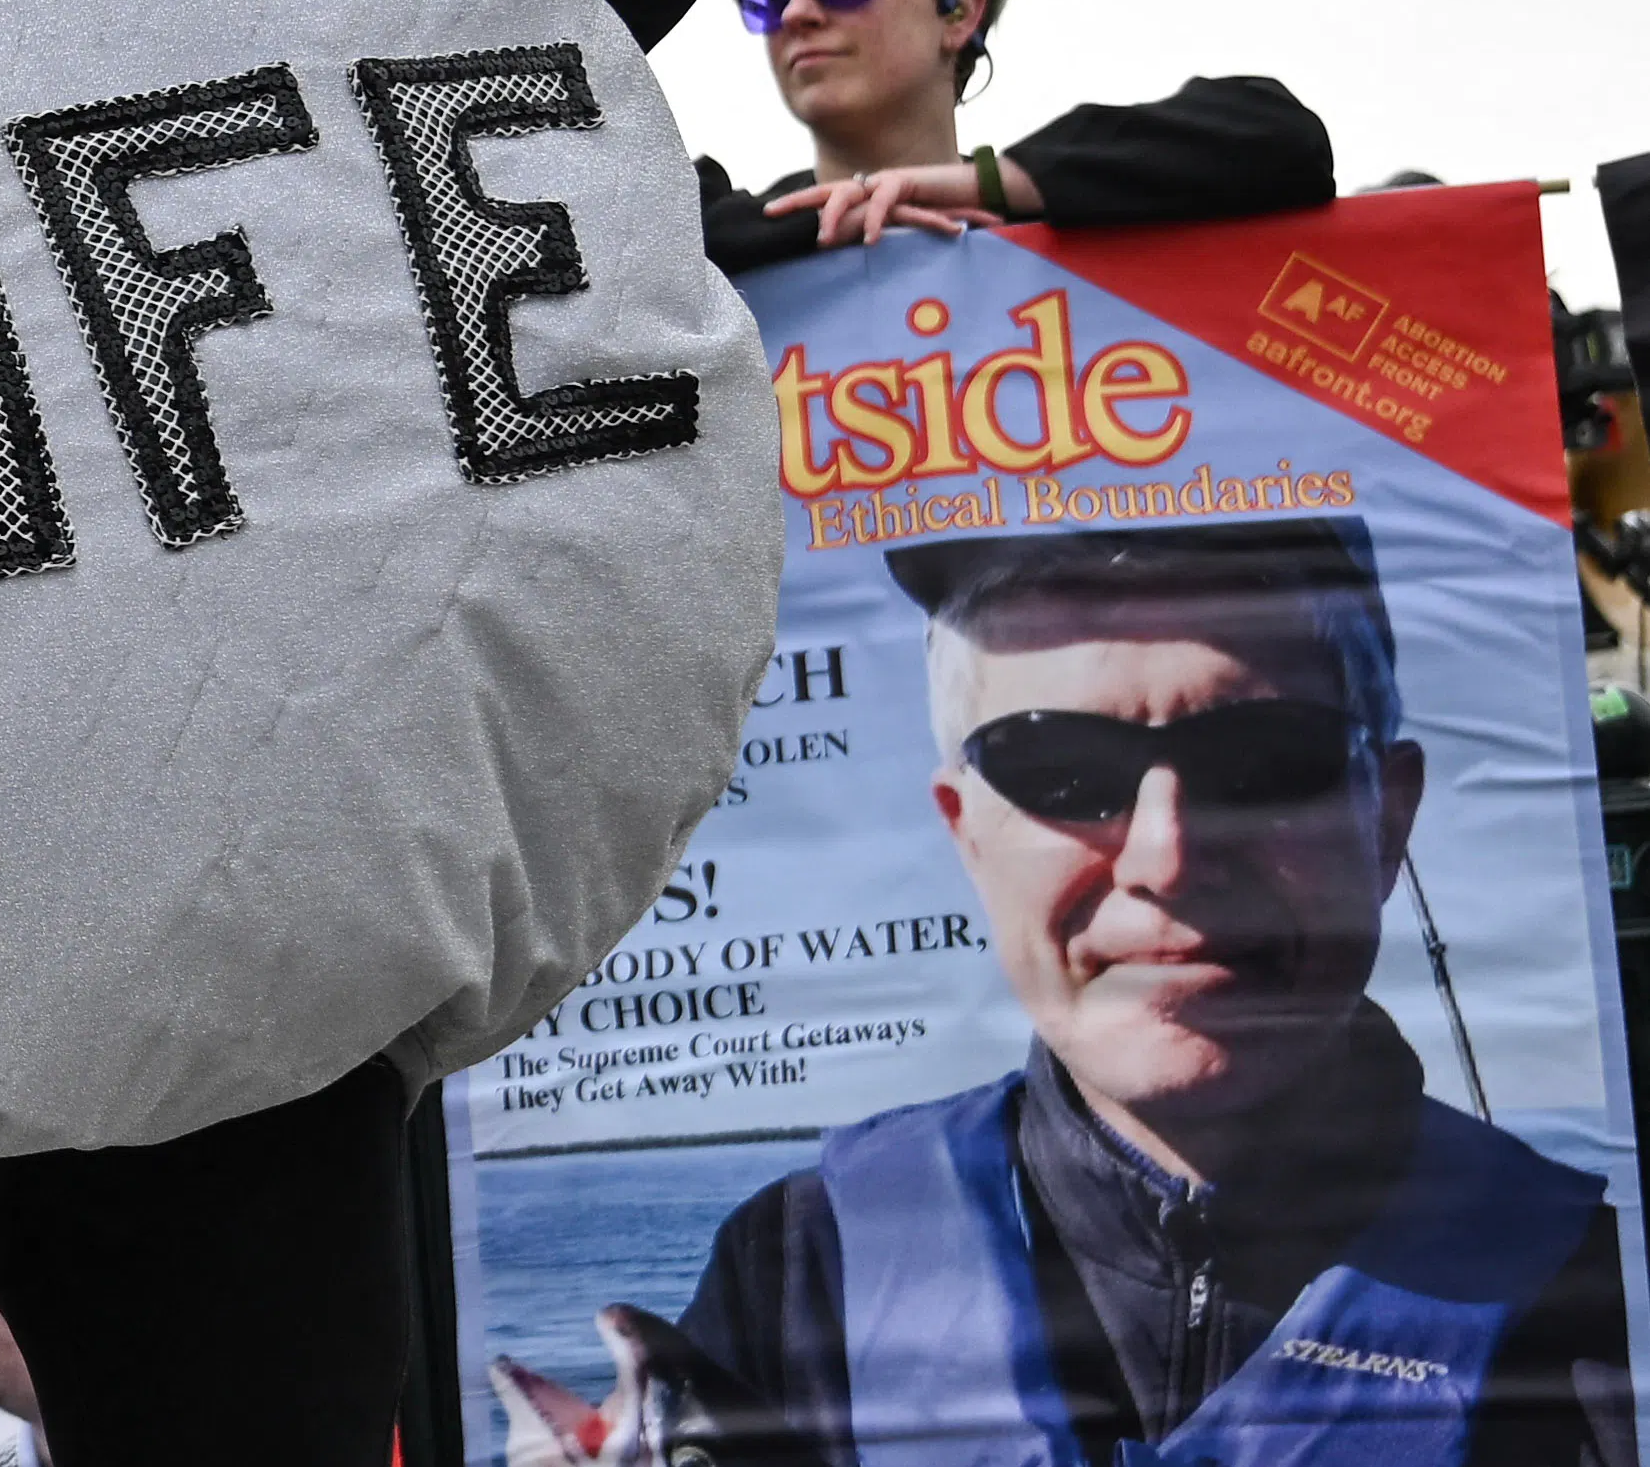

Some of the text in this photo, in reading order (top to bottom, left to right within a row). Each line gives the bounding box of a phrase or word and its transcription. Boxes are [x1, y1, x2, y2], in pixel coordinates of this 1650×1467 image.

[1368, 353, 1443, 401] FRONT
[1379, 335, 1469, 390] ACCESS
[1393, 314, 1507, 384] ABORTION
[1246, 330, 1432, 443] aafront.org
[803, 460, 1354, 553] Ethical Boundaries
[721, 933, 785, 971] OF
[797, 912, 989, 963] WATER,
[579, 981, 766, 1033] CHOICE
[496, 1016, 927, 1080] The Supreme Court Getaways
[496, 1057, 807, 1113] They Get Away With!
[1270, 1339, 1431, 1382] STEARNS
